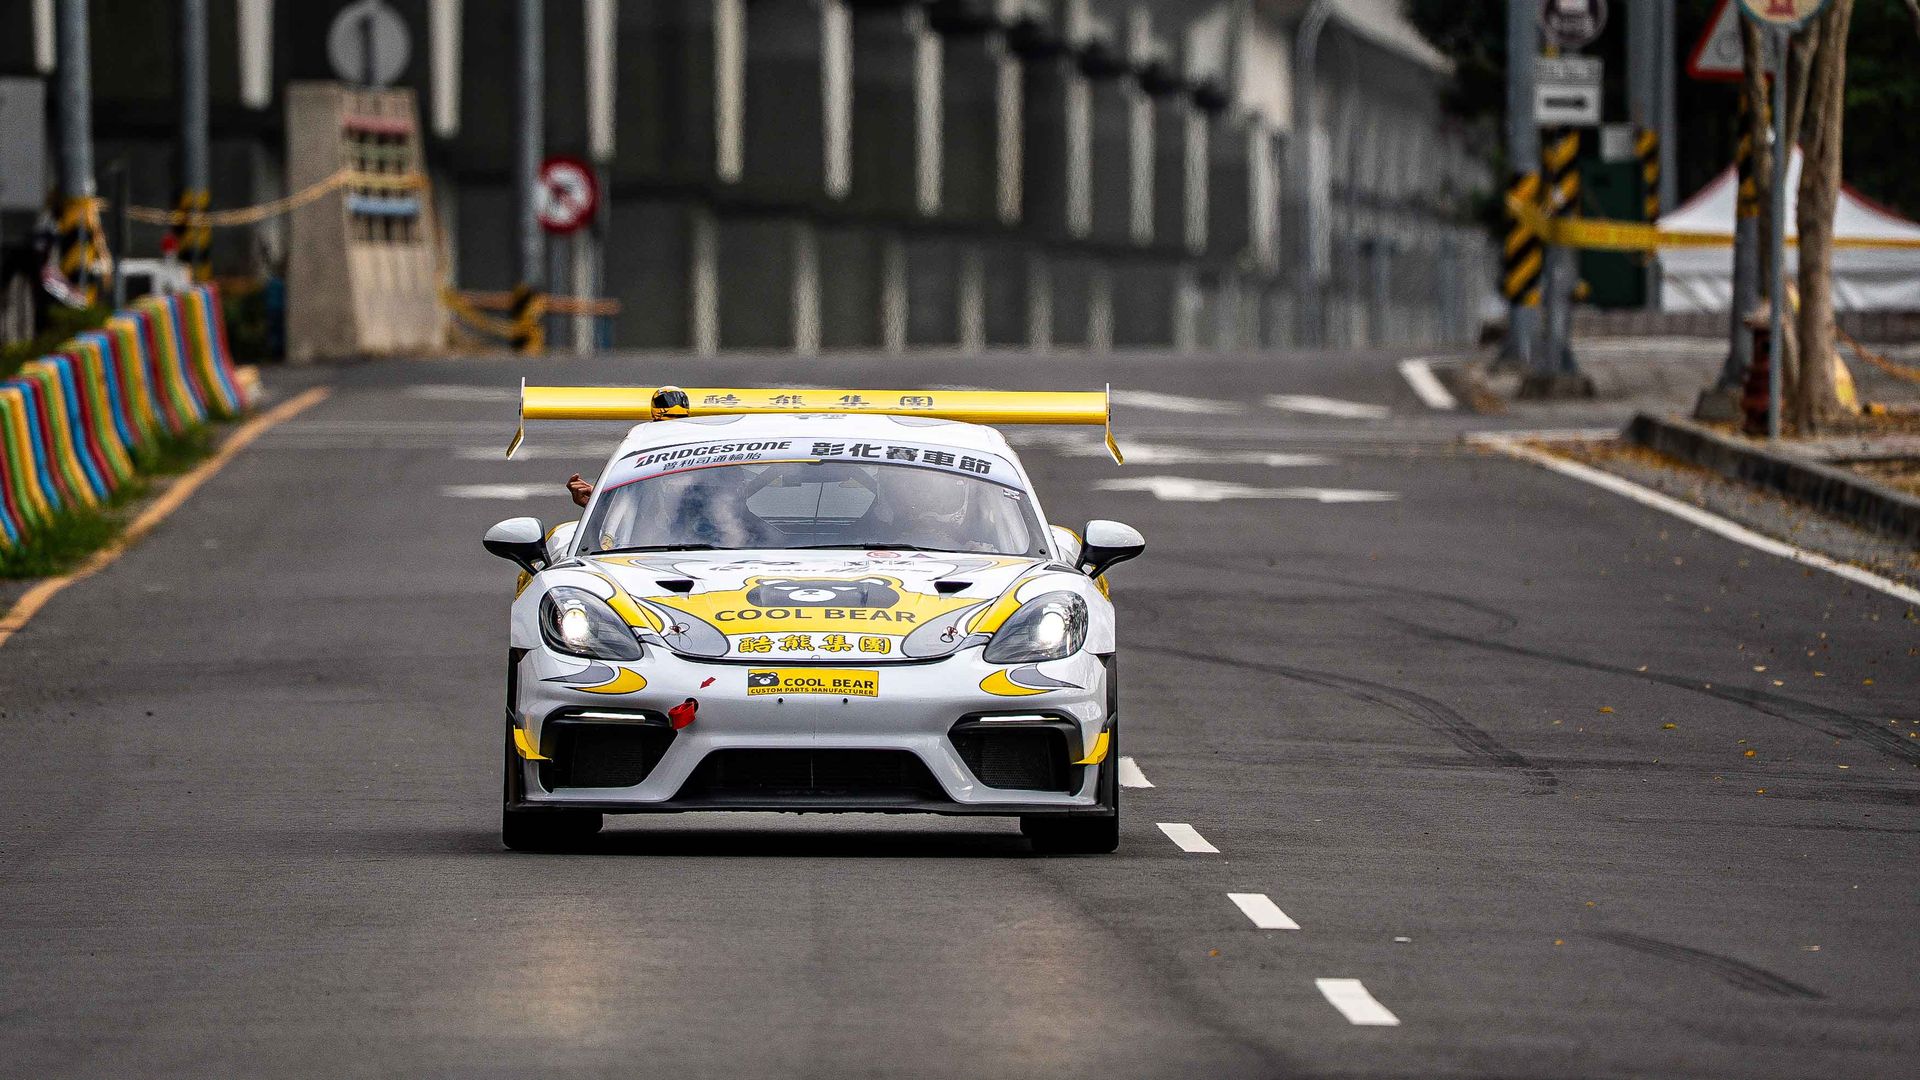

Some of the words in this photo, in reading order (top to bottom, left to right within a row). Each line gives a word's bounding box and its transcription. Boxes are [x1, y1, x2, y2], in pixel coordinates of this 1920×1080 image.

[634, 441, 792, 468] BRIDGESTONE
[663, 452, 762, 471] 普利司通輪胎
[714, 608, 812, 621] COOL
[824, 609, 916, 623] BEAR
[738, 634, 892, 655] 酷熊集團
[783, 677, 824, 687] COOL
[832, 678, 874, 689] BEAR
[811, 687, 874, 695] MANUFACTURER
